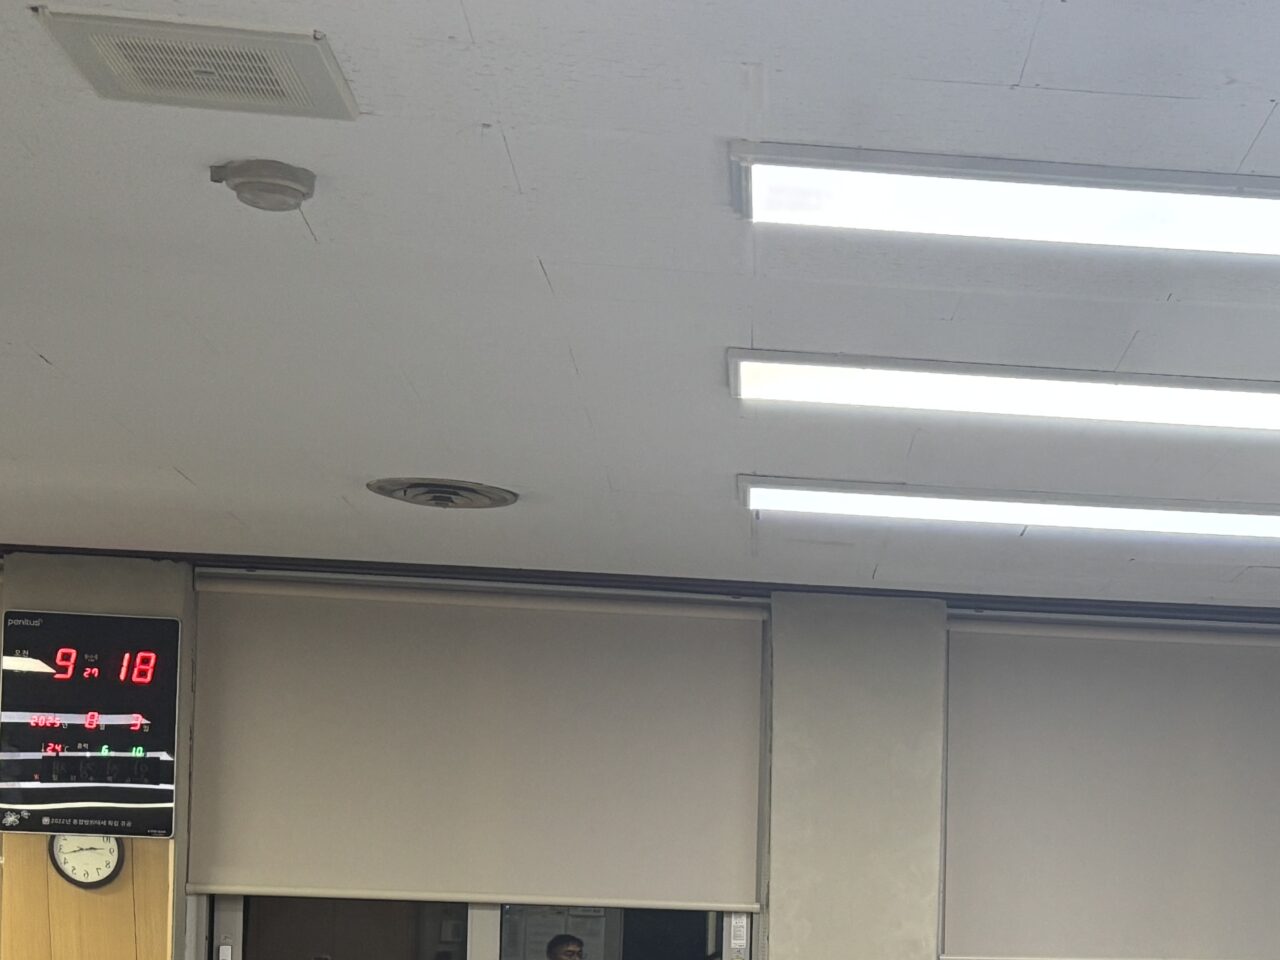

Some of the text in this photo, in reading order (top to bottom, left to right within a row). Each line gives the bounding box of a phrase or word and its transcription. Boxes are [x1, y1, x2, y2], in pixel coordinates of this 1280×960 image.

[54, 648, 157, 683] 9 18
[85, 711, 99, 729] 8
[130, 713, 143, 731] 3
[47, 743, 62, 753] 24
